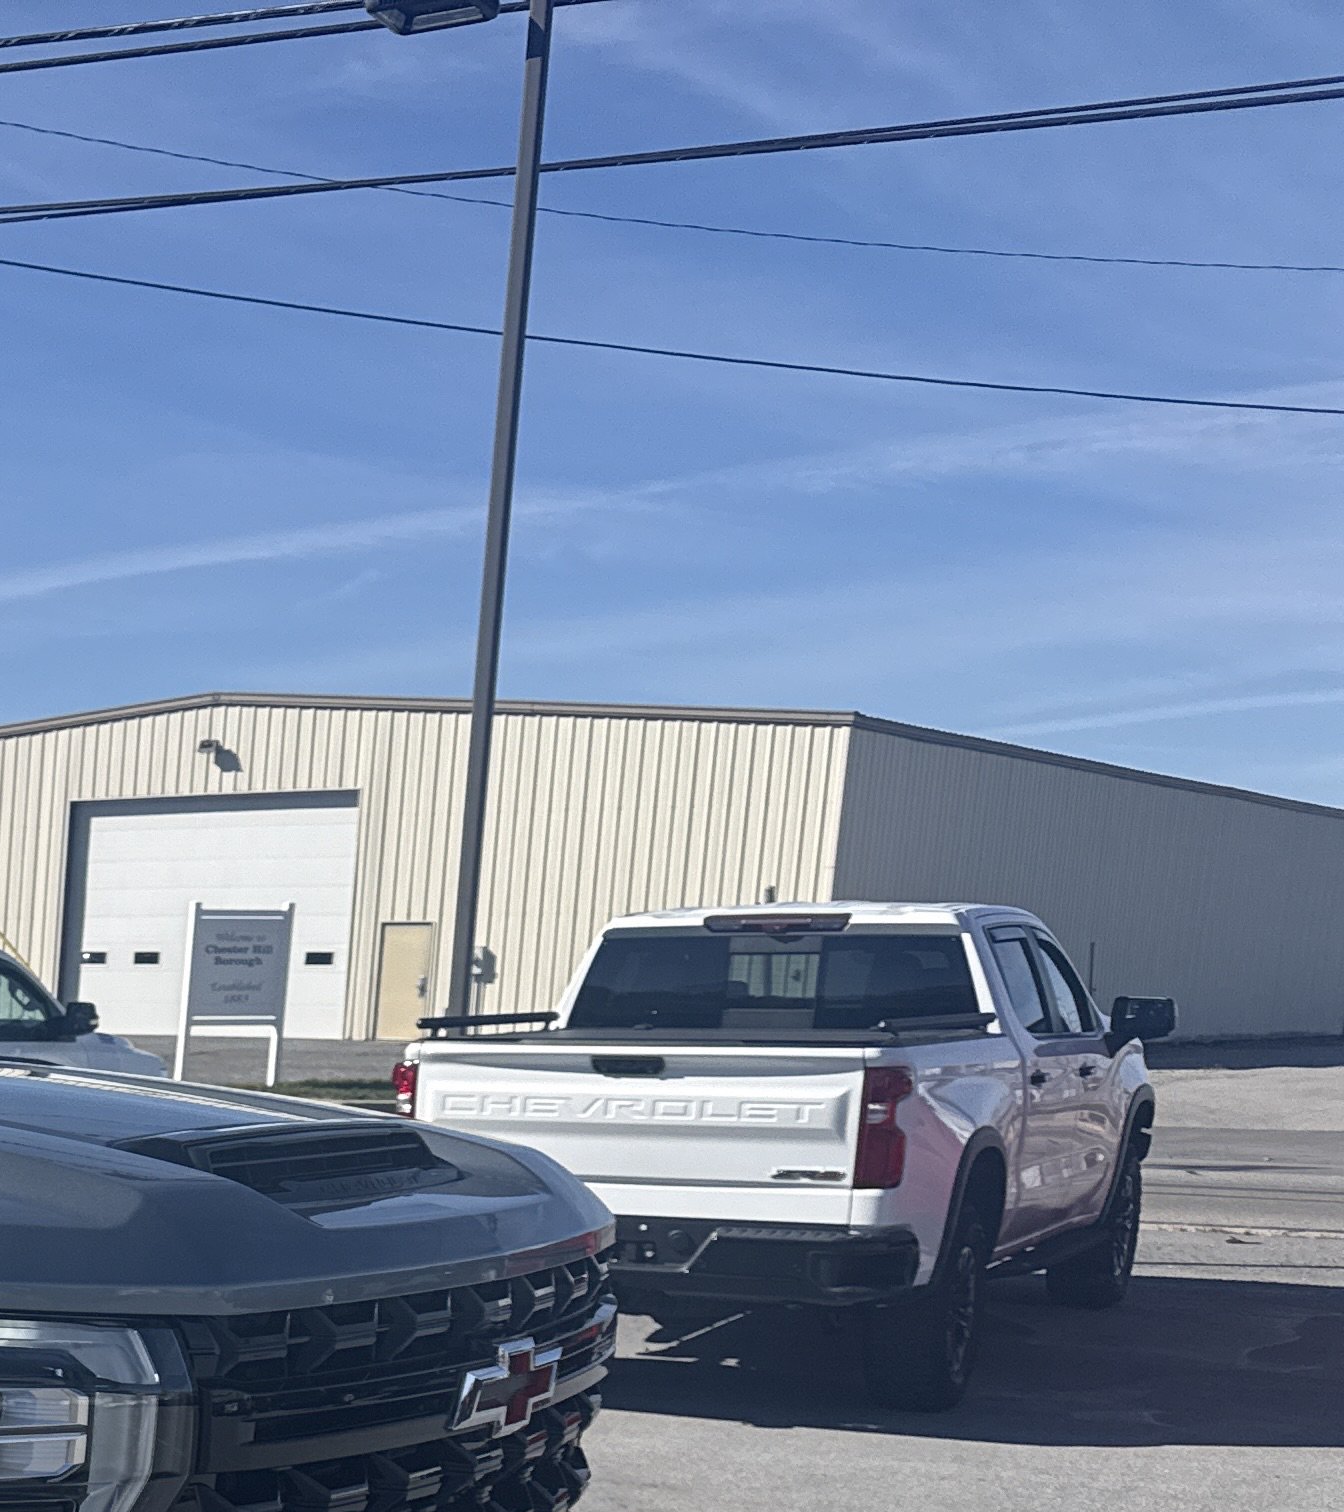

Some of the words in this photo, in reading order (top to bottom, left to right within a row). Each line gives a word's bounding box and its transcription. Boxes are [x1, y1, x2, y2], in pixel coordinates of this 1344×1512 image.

[204, 943, 249, 955] Chester
[252, 944, 273, 955] Hill
[213, 955, 264, 968] Borough
[440, 1093, 826, 1125] CHEVROLET
